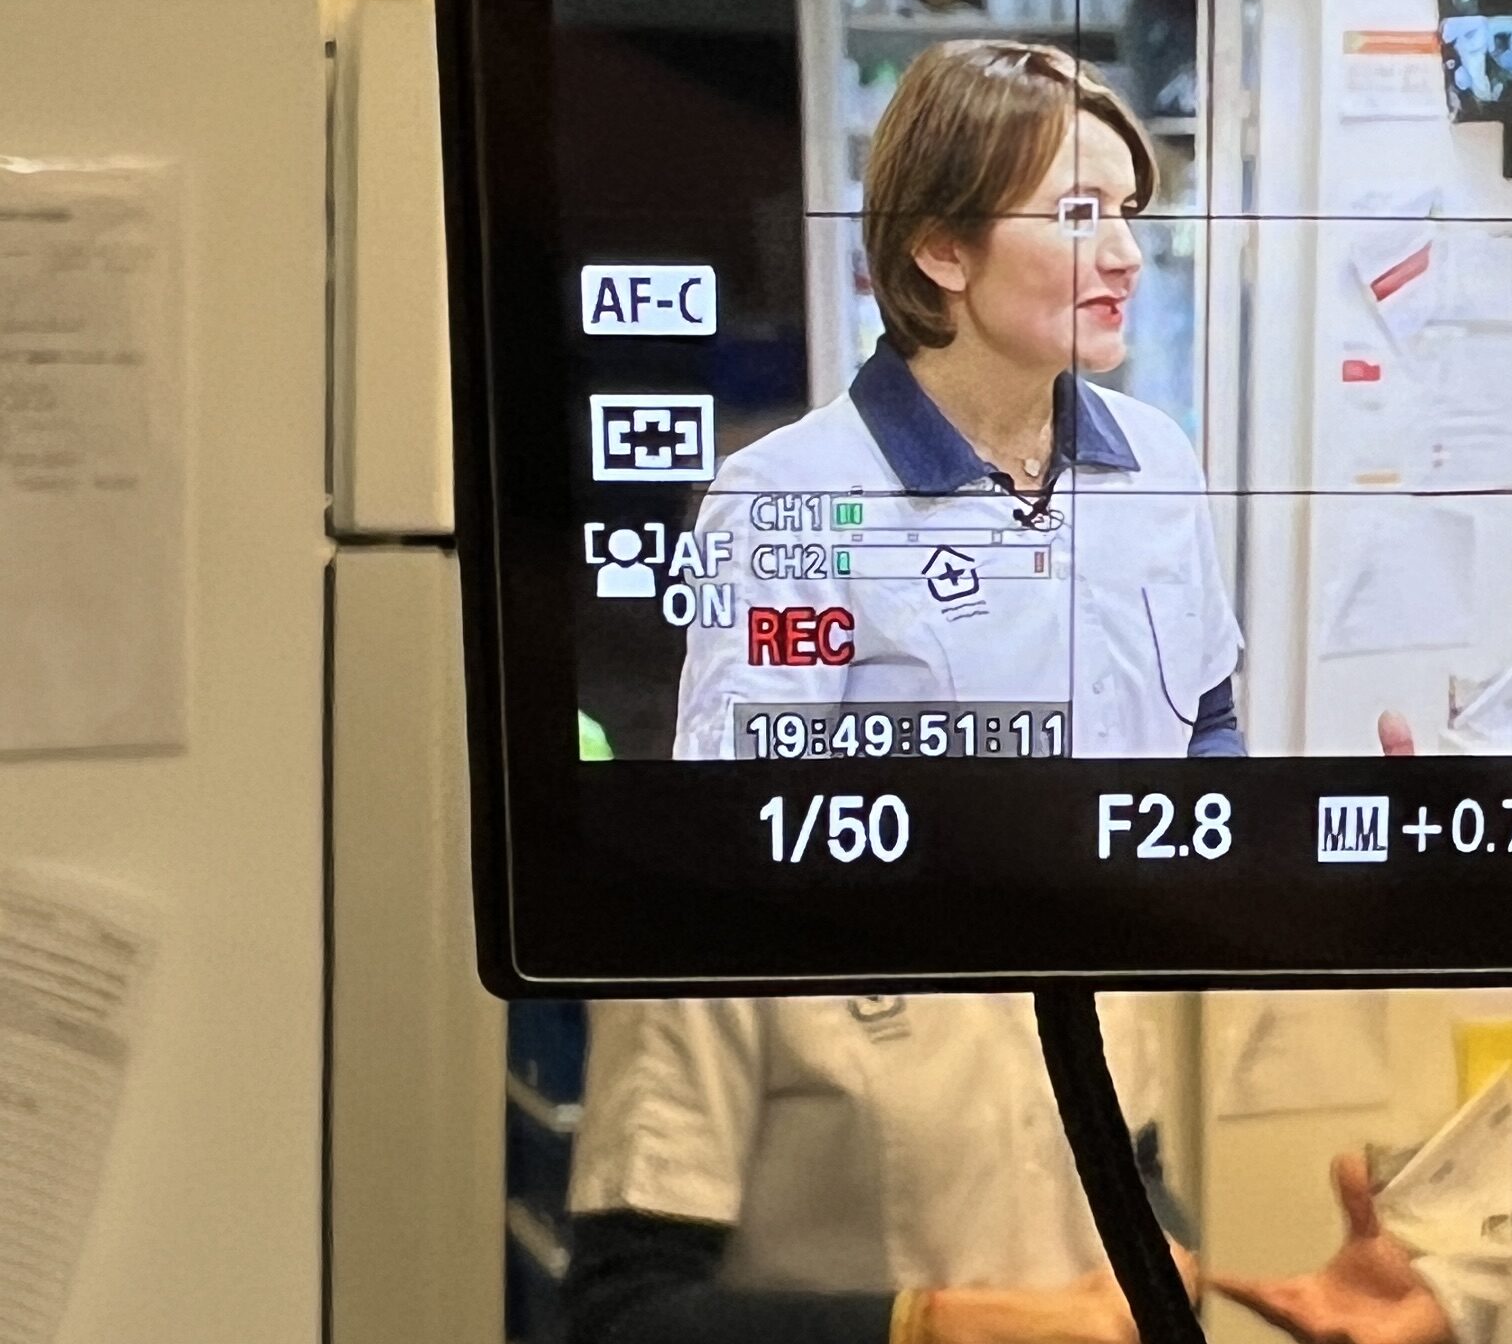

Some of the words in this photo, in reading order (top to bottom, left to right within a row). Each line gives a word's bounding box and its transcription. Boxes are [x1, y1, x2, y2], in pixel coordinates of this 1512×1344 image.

[590, 276, 704, 324] AF-C
[750, 493, 829, 531] CH1
[667, 531, 735, 579] AF
[751, 543, 828, 580] CH2
[661, 584, 737, 628] ON
[748, 607, 855, 666] REC
[746, 711, 1066, 758] 19:49:51:11
[759, 794, 910, 863] 1/50
[1098, 792, 1232, 860] F2.8
